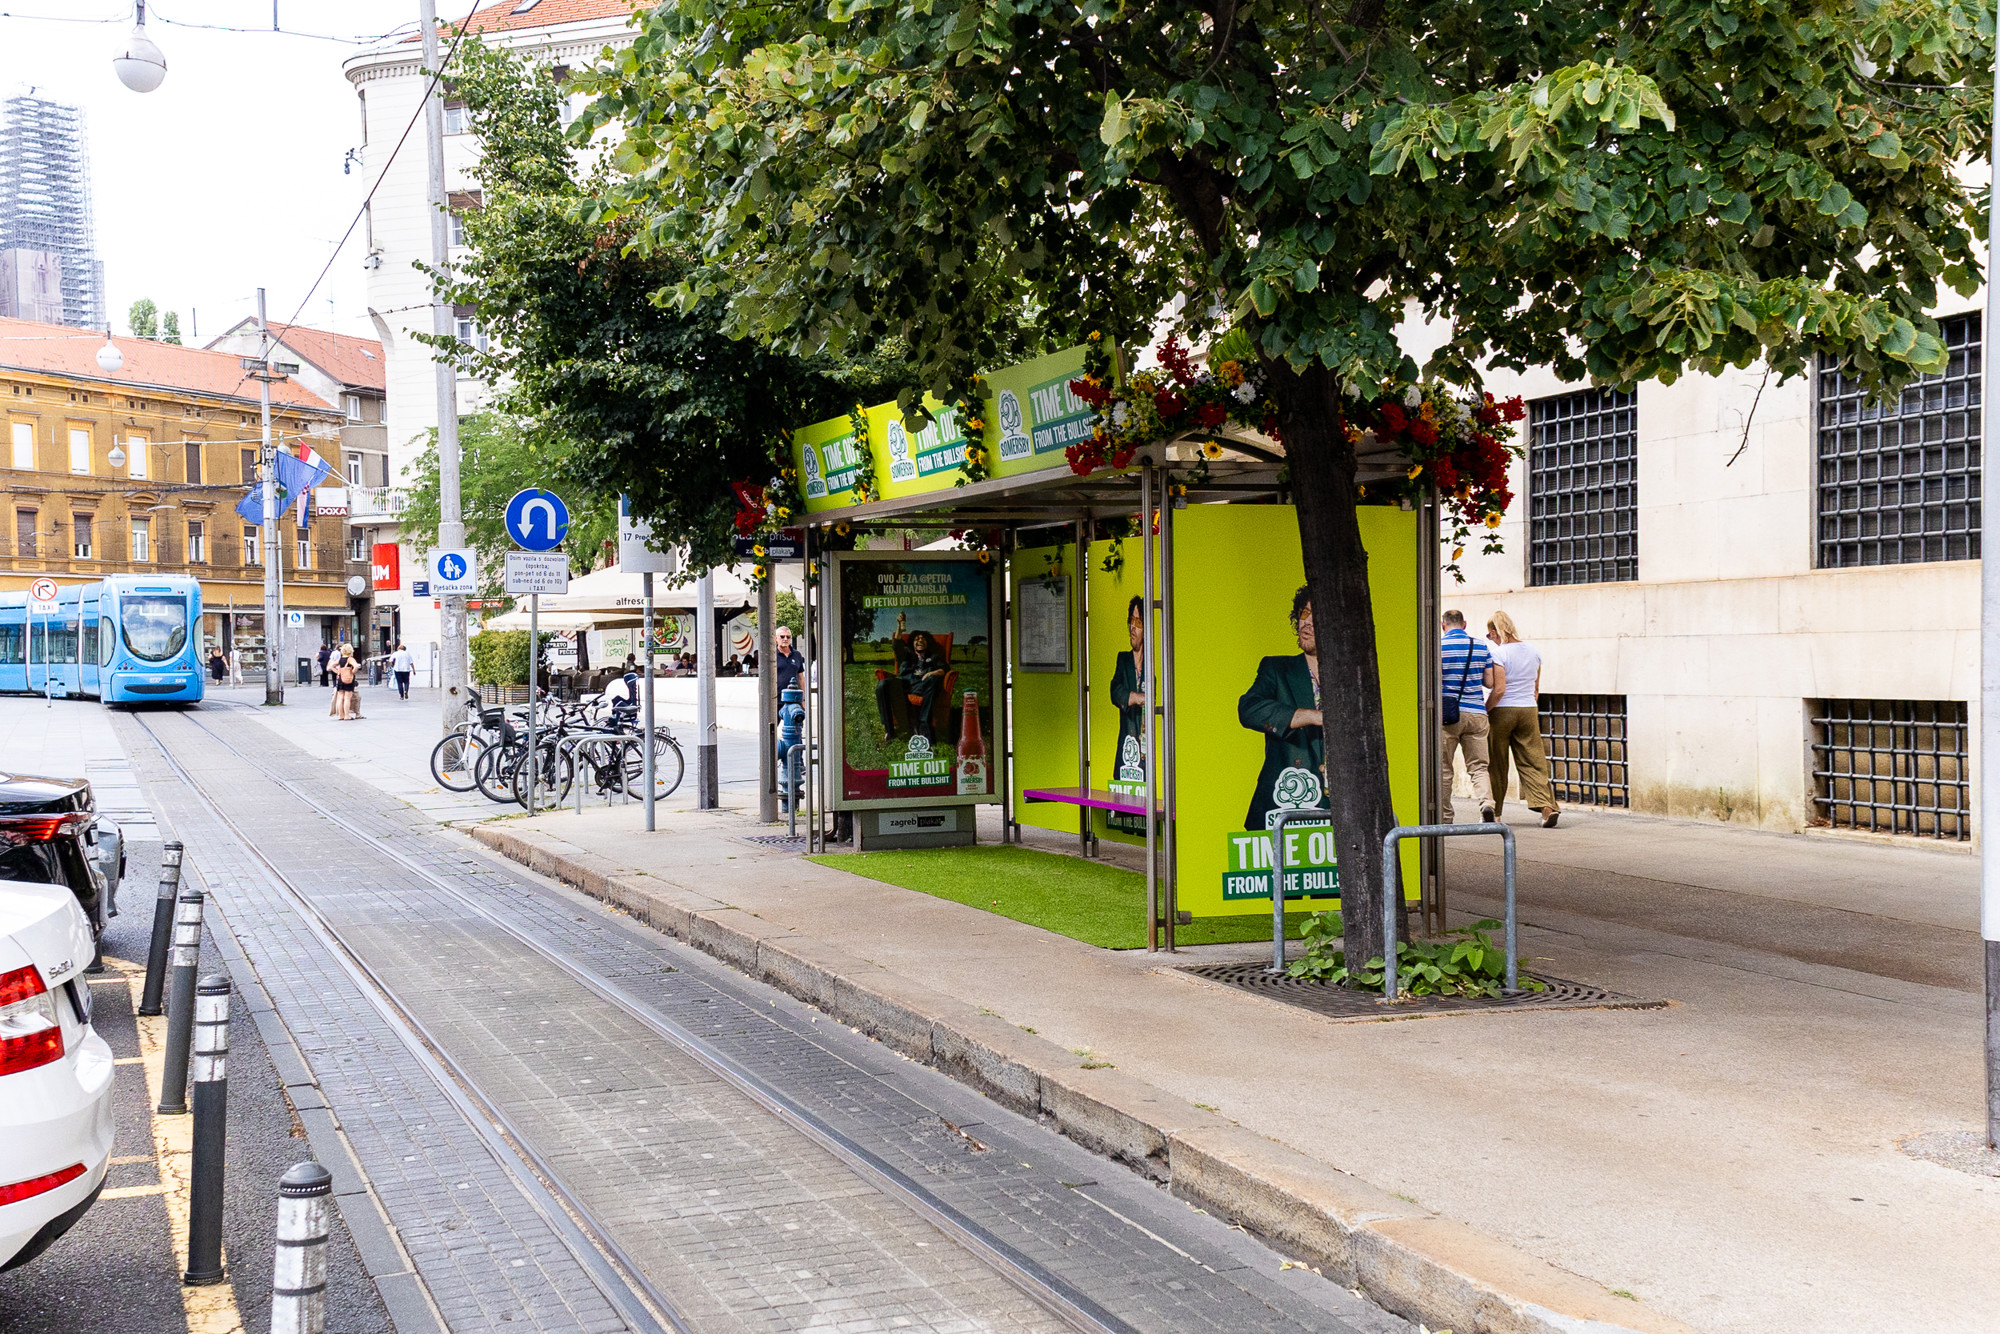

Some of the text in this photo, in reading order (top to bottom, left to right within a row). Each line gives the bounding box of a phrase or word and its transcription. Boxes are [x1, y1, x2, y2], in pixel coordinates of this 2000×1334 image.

[1030, 383, 1064, 424] TIME
[1034, 428, 1054, 449] FROM
[1052, 423, 1068, 444] THE
[1000, 437, 1030, 457] SOMERSBY
[822, 441, 845, 471] TIME
[917, 454, 934, 473] FROM
[932, 450, 945, 470] THE
[891, 462, 915, 479] SOMERSBY
[827, 475, 841, 491] FROM
[838, 472, 849, 487] THE
[318, 507, 347, 516] DOXA
[623, 533, 632, 541] 17
[877, 574, 952, 583] OVO JE ZA @PETRA
[883, 583, 948, 594] KOJI RAZMIŠLJA
[865, 594, 967, 607] O PETKU OD PONEDJELJKA
[891, 760, 947, 777] TIME OUT
[888, 775, 950, 787] FROM THE BULLSHIT
[890, 818, 917, 828] zagreb
[1227, 875, 1269, 895] FROM
[1272, 873, 1300, 891] HE
